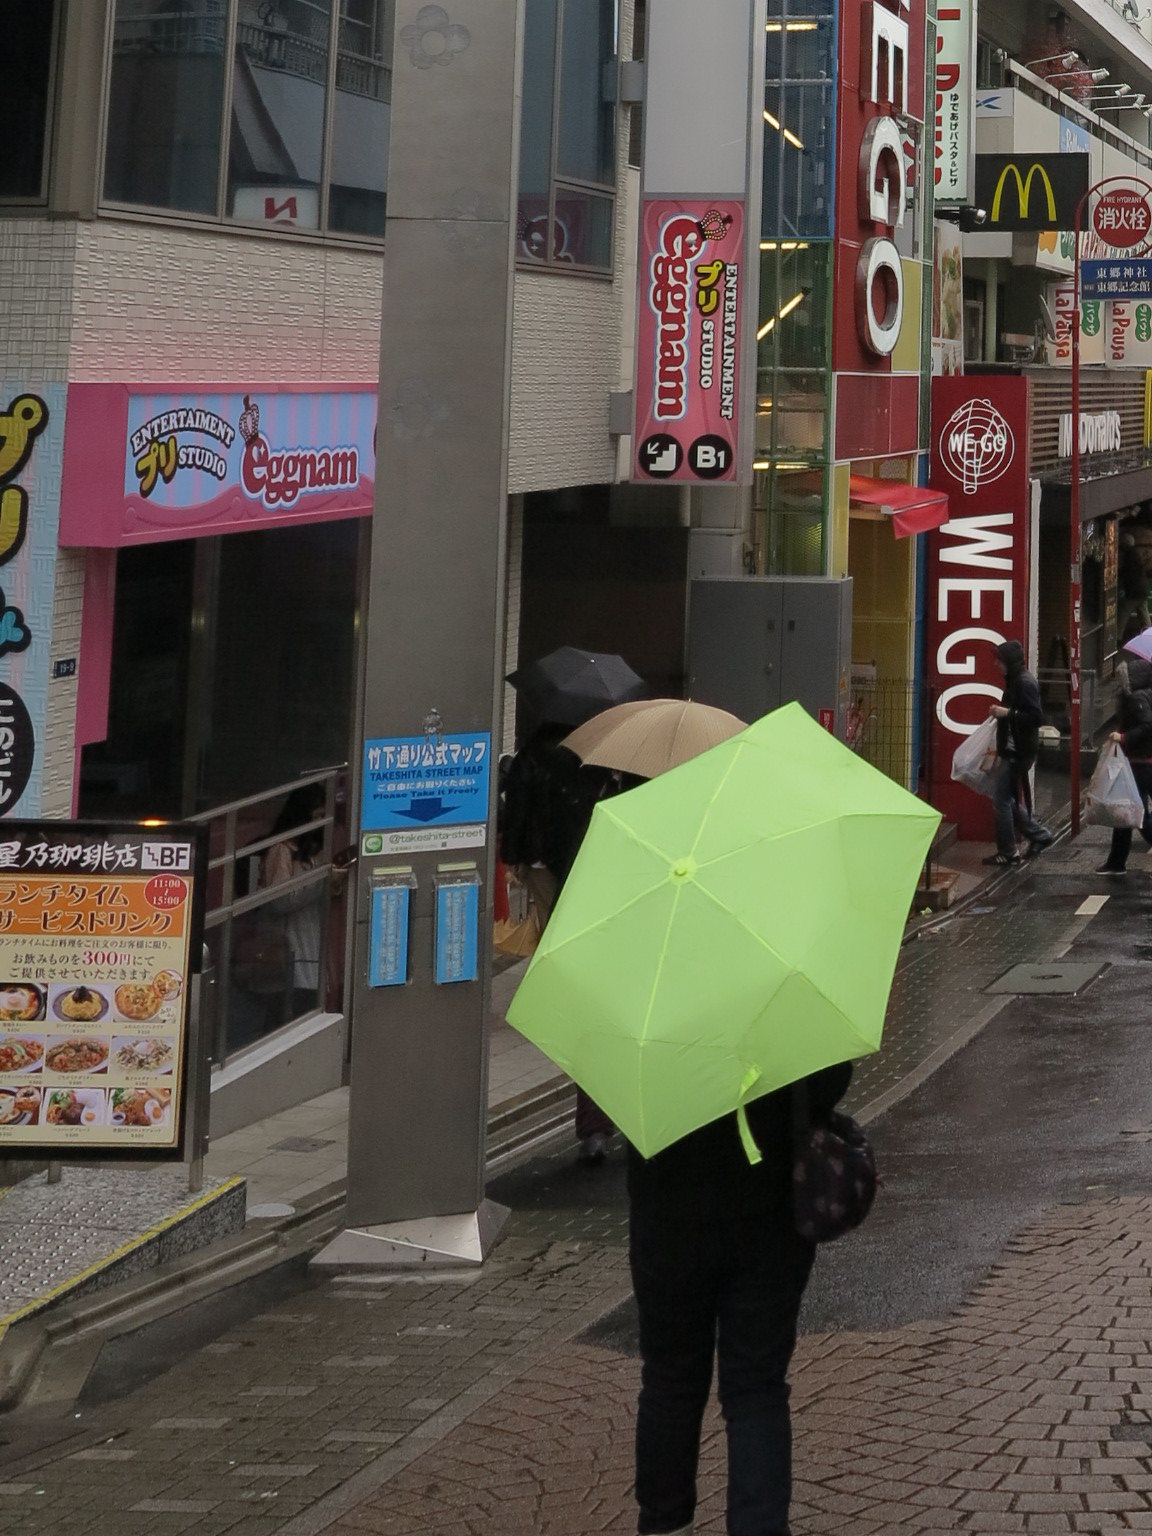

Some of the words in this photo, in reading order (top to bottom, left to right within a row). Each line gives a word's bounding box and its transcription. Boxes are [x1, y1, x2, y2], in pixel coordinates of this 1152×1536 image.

[1103, 196, 1115, 204] FIRE
[1117, 196, 1142, 204] HYDRANT
[1098, 207, 1148, 230] 消火栓
[1096, 267, 1148, 279] 東郷神社
[1096, 281, 1151, 293] 東郷記念館
[650, 215, 708, 422] eggnam
[720, 263, 738, 420] ENTERTAINMENT
[1112, 316, 1131, 361] Pausa
[699, 319, 715, 390] STUDIO
[1058, 410, 1121, 457] MDonald's
[178, 445, 227, 479] STUDIO
[697, 445, 725, 469] B1
[242, 436, 358, 505] eggnam
[936, 512, 1014, 735] WEGO
[370, 769, 423, 782] TAKESHITA
[425, 767, 462, 778] STREET
[463, 765, 483, 776] MAP
[0, 840, 142, 873] 星乃珈琲店
[160, 846, 187, 867] BF
[0, 882, 130, 908] ランチタイム
[153, 878, 181, 888] 11:00
[152, 896, 180, 906] 15:00
[0, 910, 173, 935] サービスドリンク
